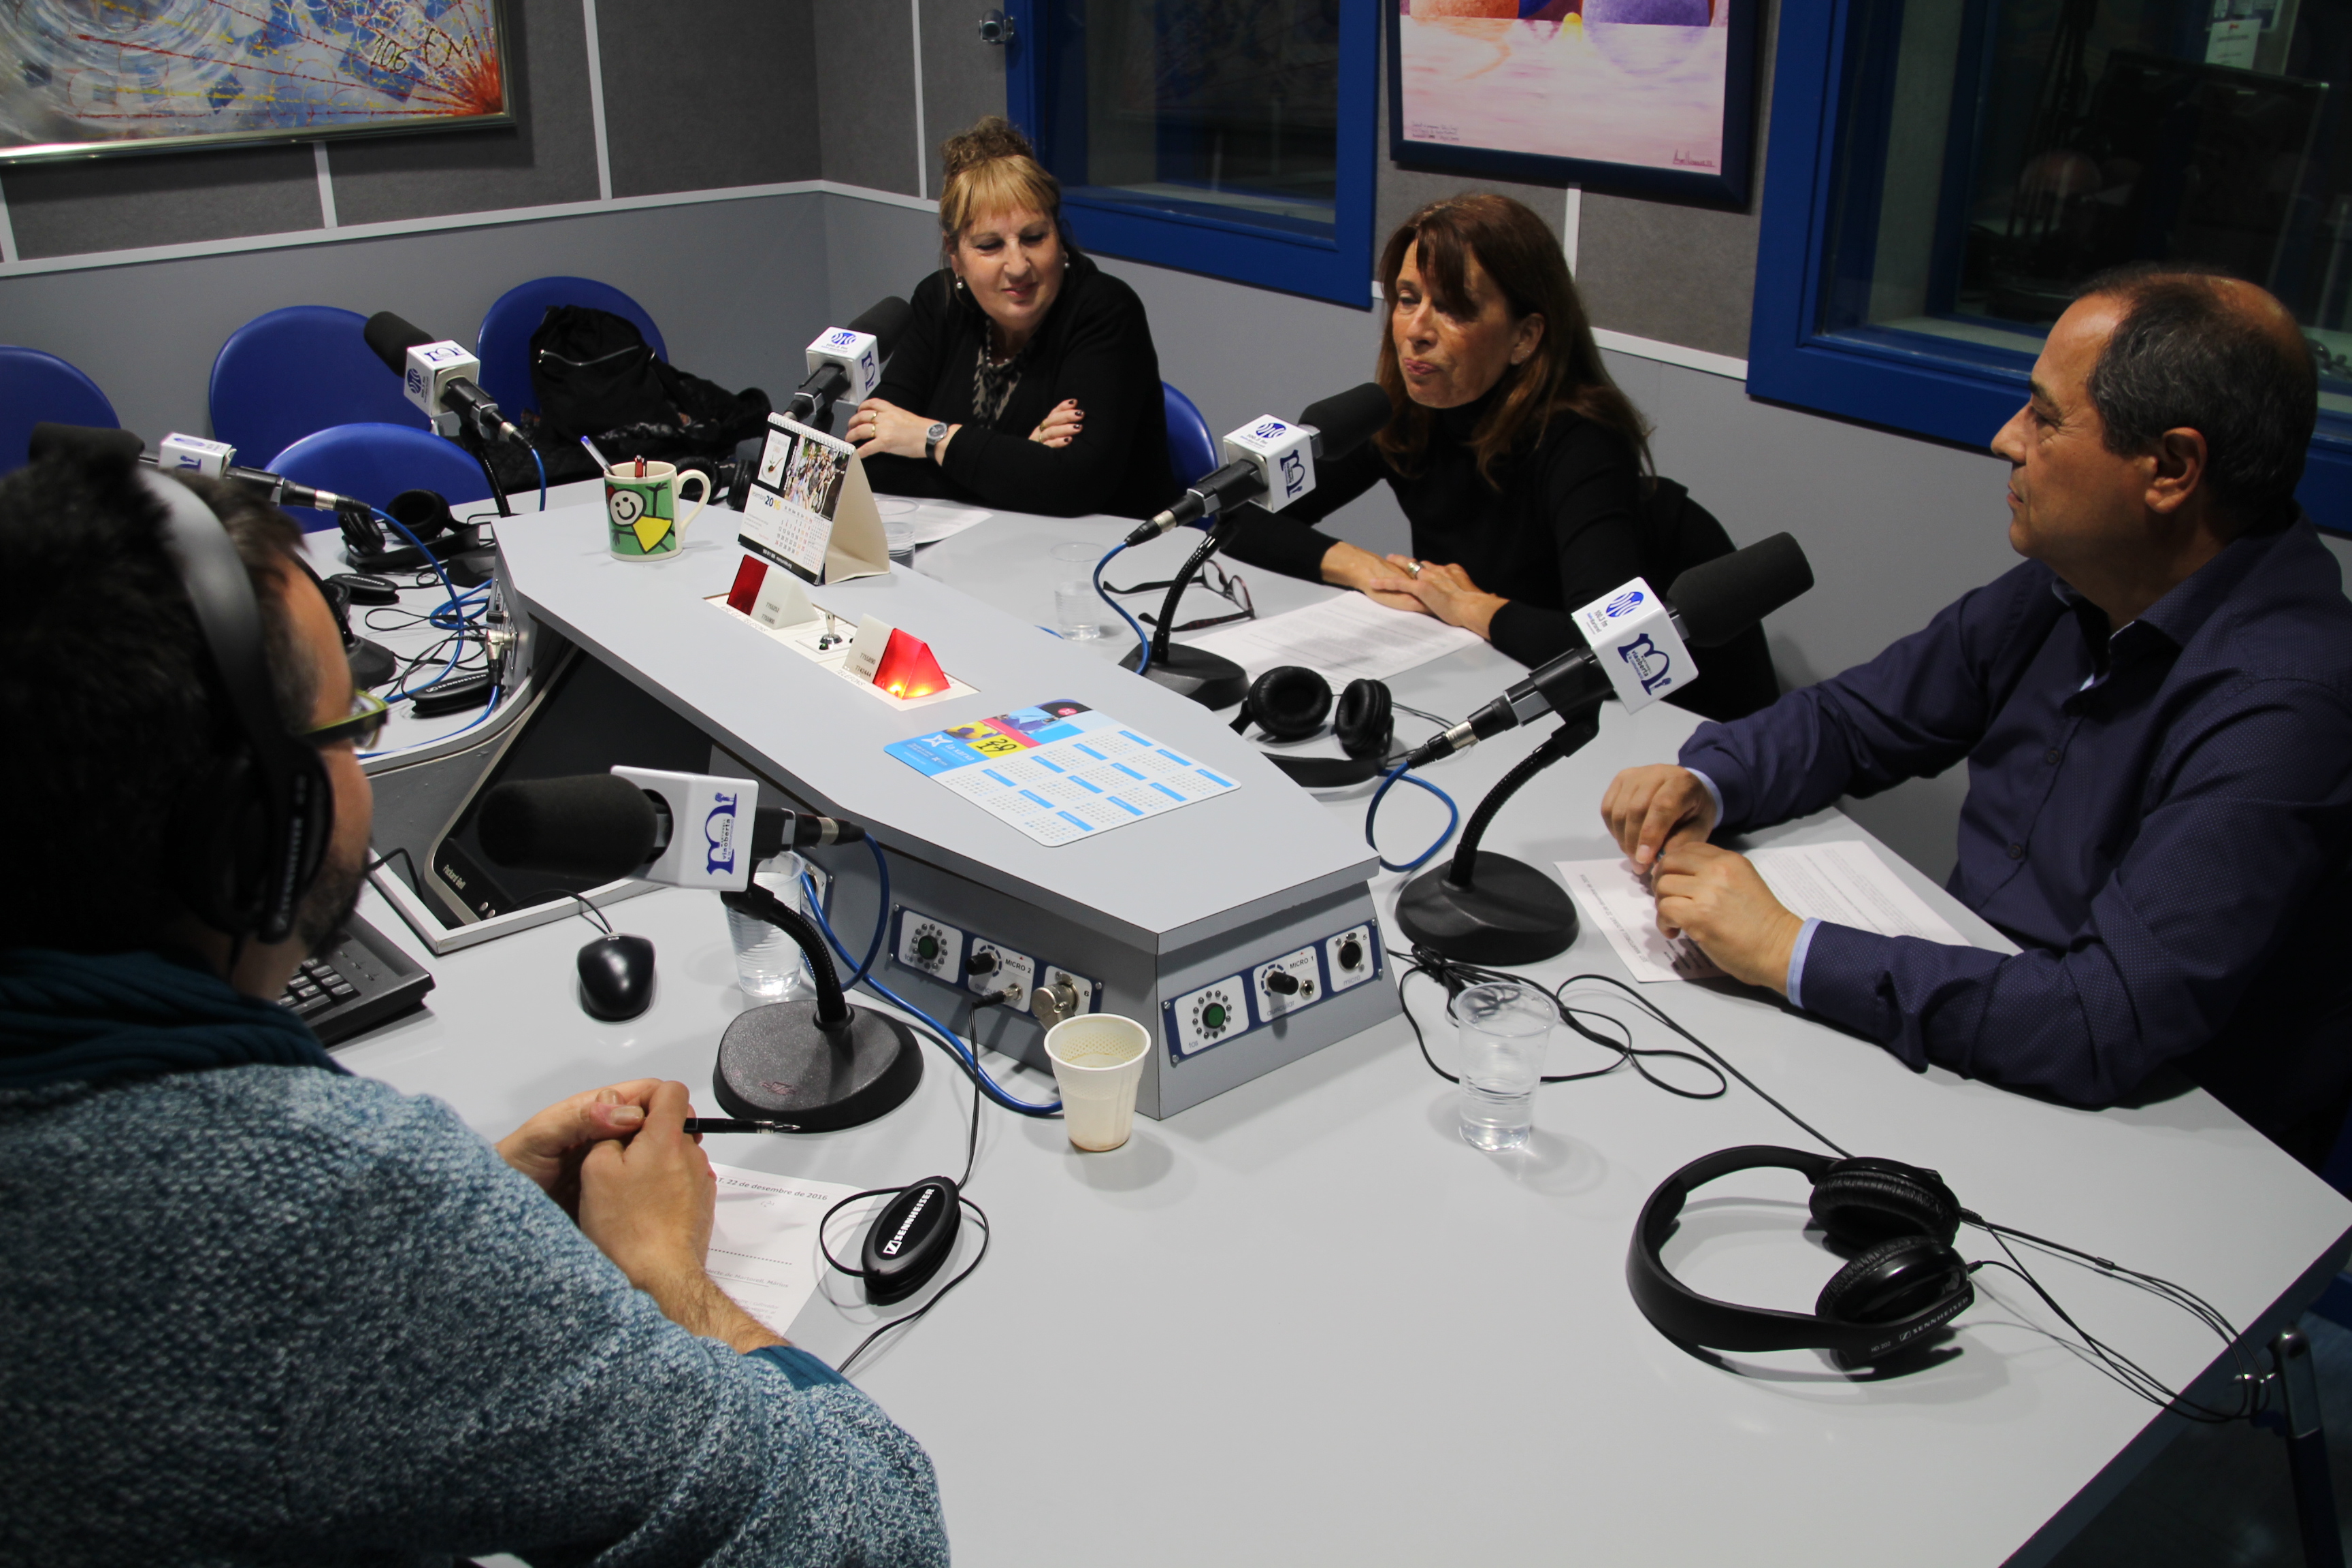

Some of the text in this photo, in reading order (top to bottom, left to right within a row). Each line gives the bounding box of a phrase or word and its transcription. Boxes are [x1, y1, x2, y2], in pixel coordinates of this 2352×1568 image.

[1004, 958, 1026, 971] MICRO
[1289, 958, 1309, 970] MICRO
[1343, 975, 1361, 987] micro
[1266, 1000, 1296, 1017] auricular
[751, 1183, 793, 1195] desembre
[894, 1188, 936, 1241] SENNHEISER
[1912, 1296, 1969, 1334] SENNHEISER
[1880, 1341, 1891, 1349] 202
